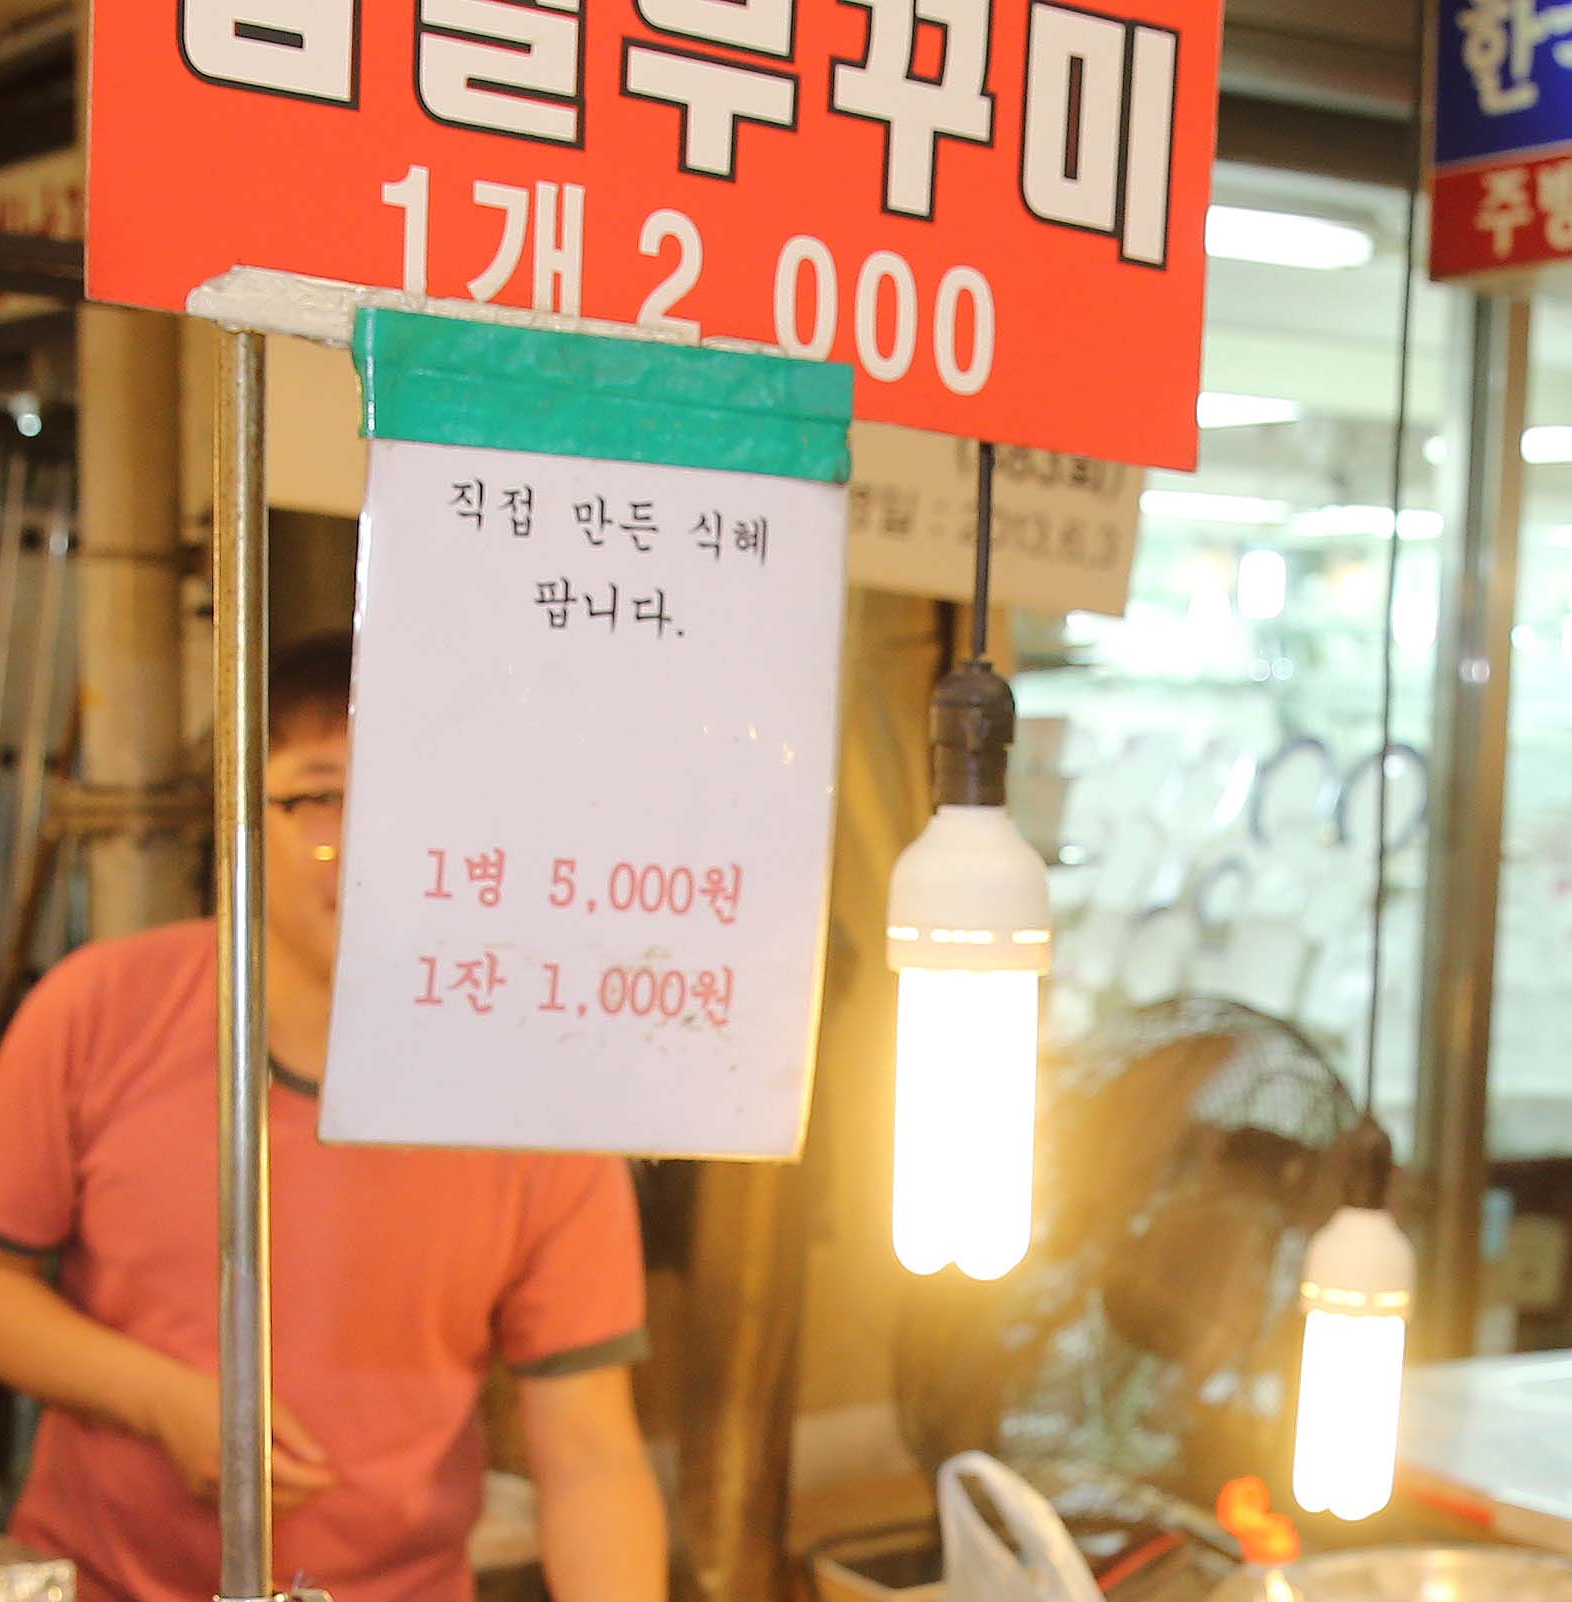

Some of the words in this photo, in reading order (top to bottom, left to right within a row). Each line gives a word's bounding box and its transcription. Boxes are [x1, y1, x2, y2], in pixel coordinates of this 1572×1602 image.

[382, 165, 584, 320] 1개
[449, 478, 536, 539] 직접
[571, 495, 659, 554] 만든
[688, 508, 770, 566] 식혜
[533, 575, 687, 640] 팝니다.
[424, 848, 508, 908] 1병
[548, 857, 744, 925] 5,000원
[413, 952, 506, 1014] 1잔
[537, 963, 736, 1025] 1,000원
